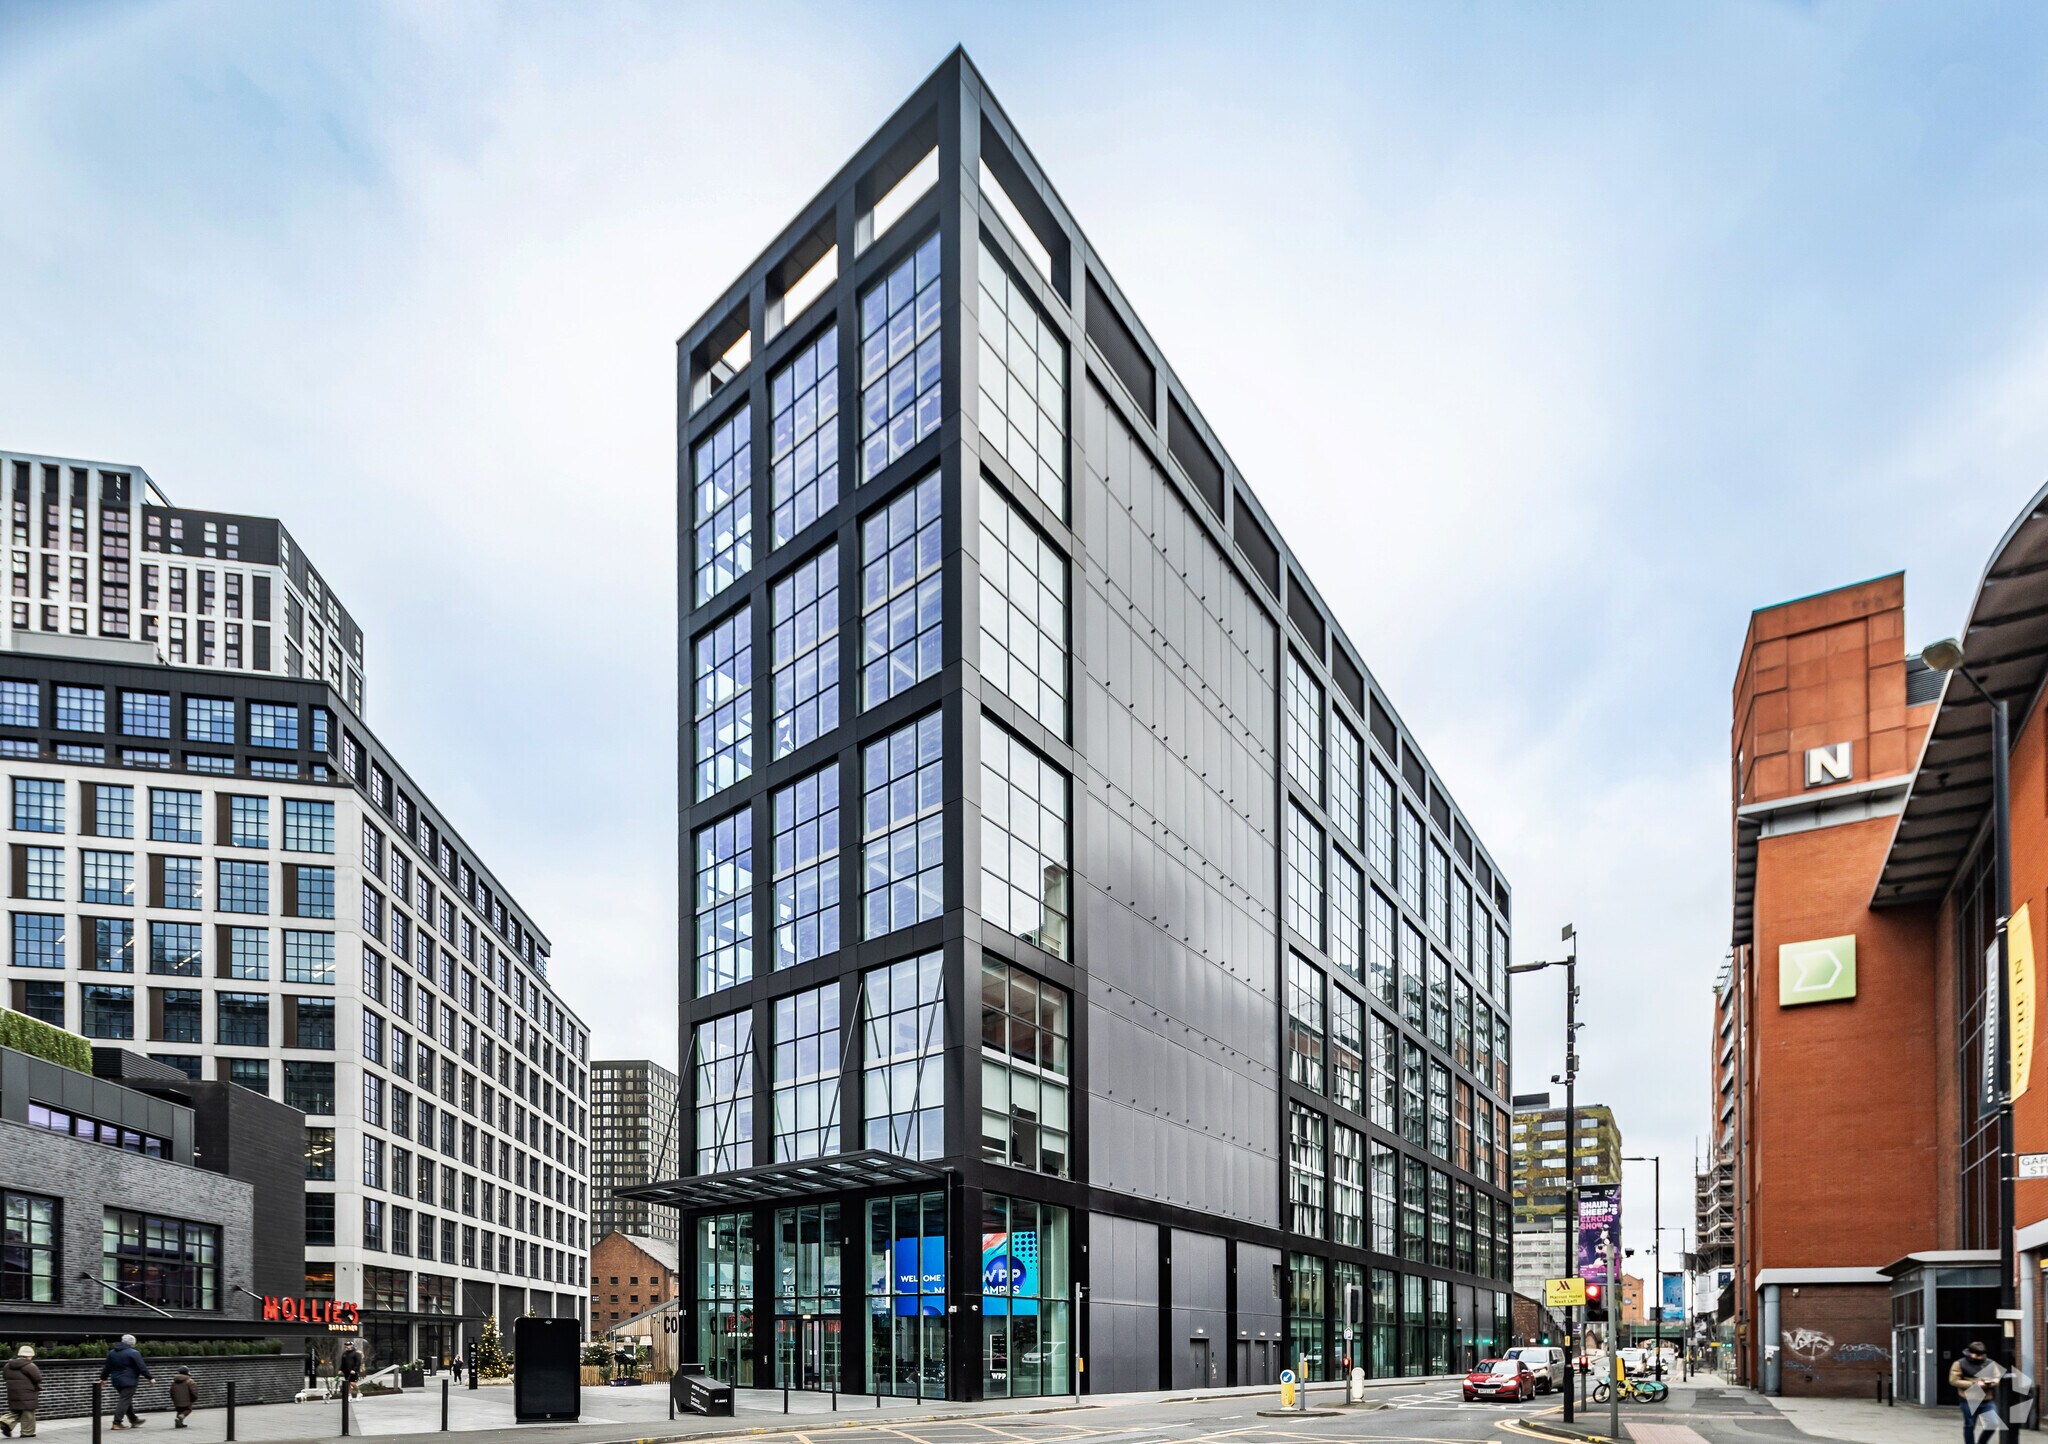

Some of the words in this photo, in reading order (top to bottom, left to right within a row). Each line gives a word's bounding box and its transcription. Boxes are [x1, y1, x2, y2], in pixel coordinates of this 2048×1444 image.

[1809, 741, 1850, 784] N
[2030, 1165, 2048, 1175] ST
[1580, 1201, 1609, 1209] SHAUN
[1580, 1207, 1618, 1216] SHEEP'S
[1580, 1215, 1614, 1223] CIRCUS
[900, 1274, 941, 1283] WELOME
[982, 1285, 1020, 1295] AMPS
[263, 1295, 359, 1324] MOLLIE'S
[991, 1372, 1007, 1380] WPP
